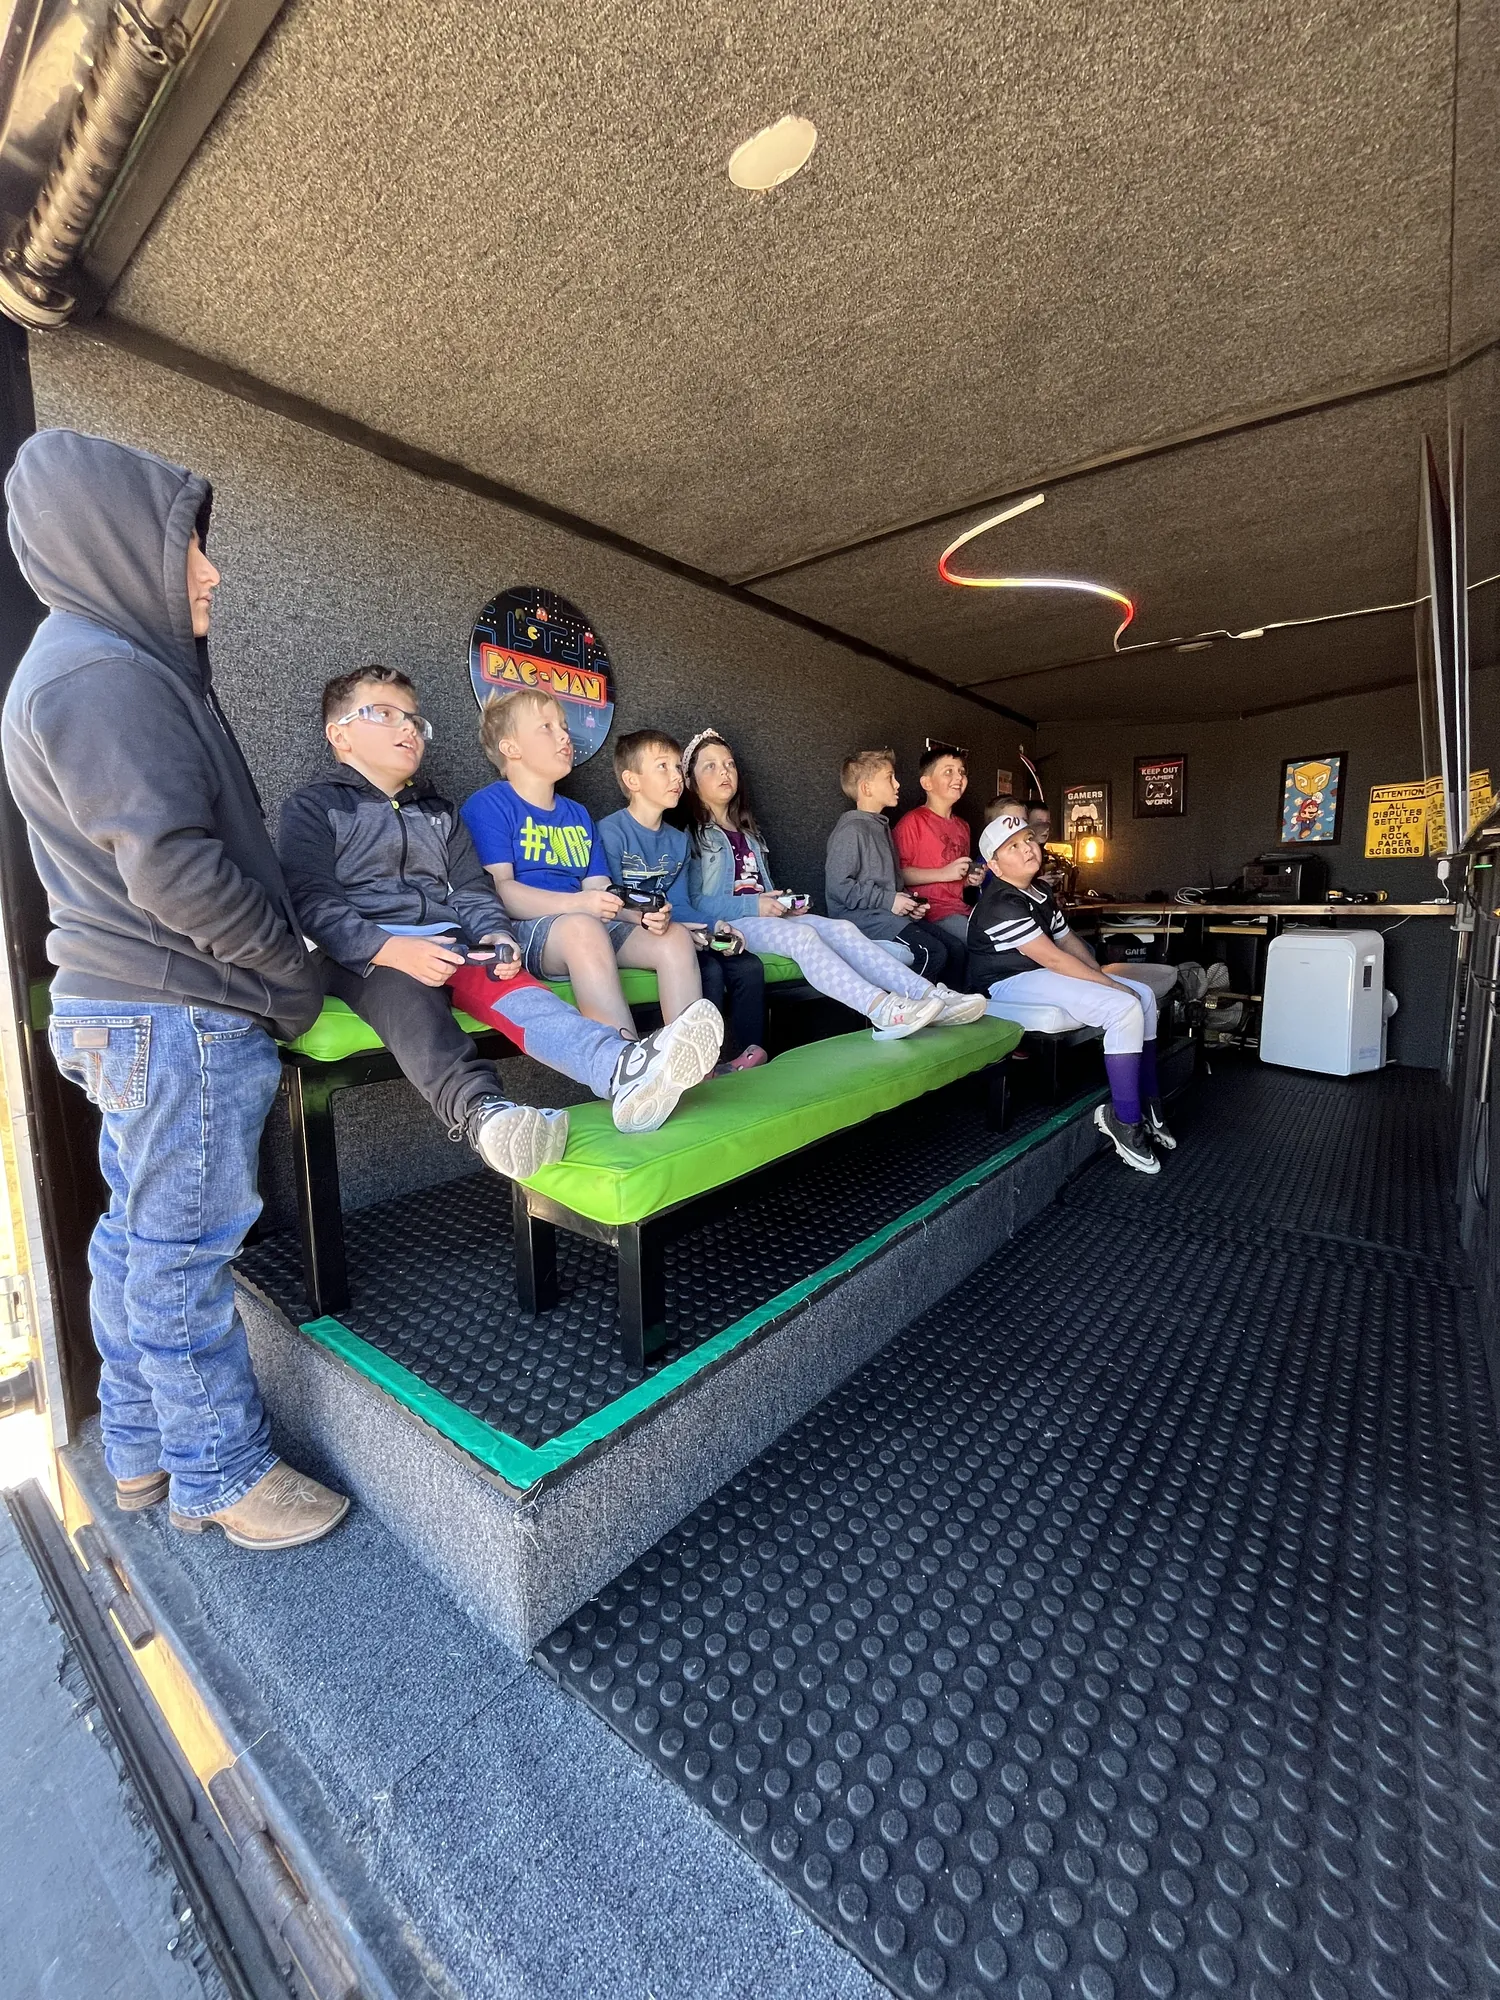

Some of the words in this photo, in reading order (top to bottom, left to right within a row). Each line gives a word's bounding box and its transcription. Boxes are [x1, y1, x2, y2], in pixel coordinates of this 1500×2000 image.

[486, 650, 601, 701] PAC-MAN
[1068, 791, 1103, 800] GAMERS
[1375, 788, 1424, 799] ATTENTION
[1145, 798, 1173, 806] WORK
[1373, 808, 1422, 819] DISPUTES
[1374, 816, 1419, 826] SETTLED
[1381, 832, 1409, 840] ROCK
[1377, 840, 1411, 848] PAPER
[1369, 847, 1420, 855] SCISSORS
